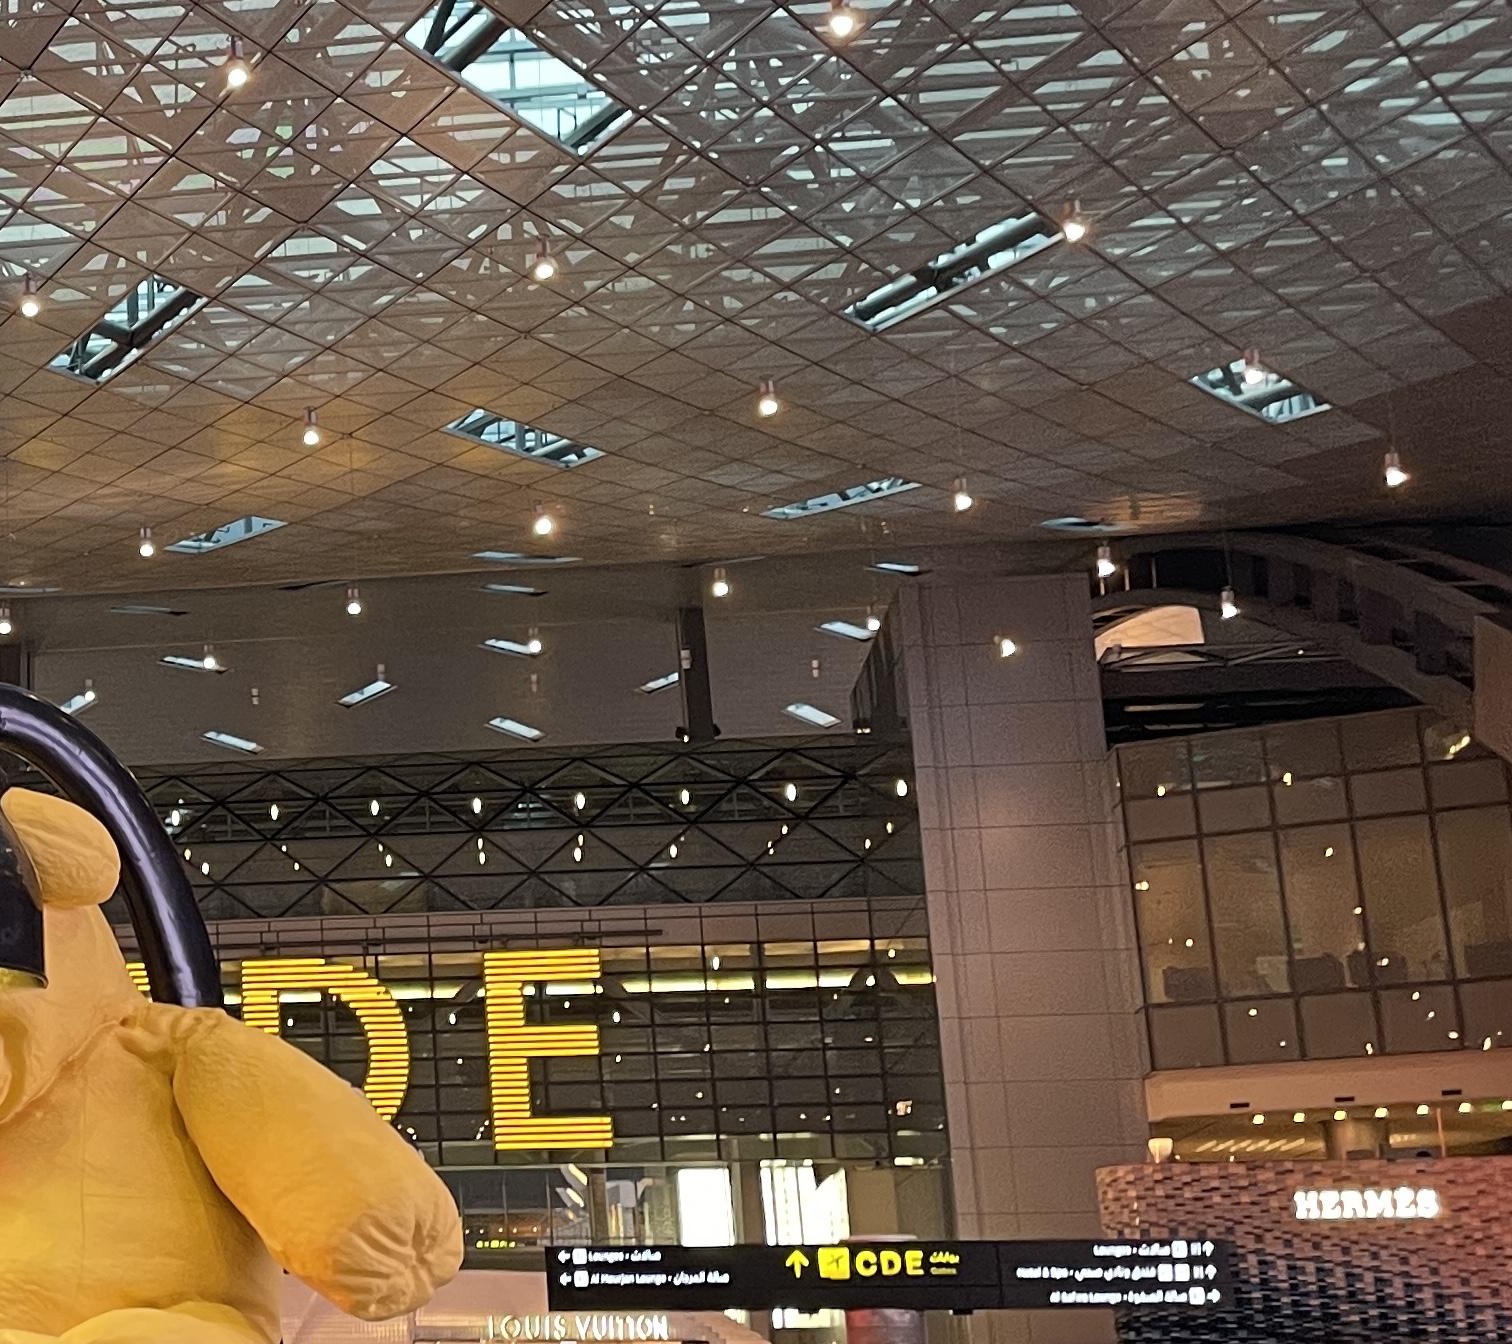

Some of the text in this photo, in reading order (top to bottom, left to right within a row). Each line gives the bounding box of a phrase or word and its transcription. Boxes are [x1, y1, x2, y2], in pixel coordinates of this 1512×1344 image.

[1293, 1186, 1440, 1220] HERMÈS
[855, 1250, 925, 1277] CDE
[488, 1313, 669, 1341] LOUIS VUITTON
